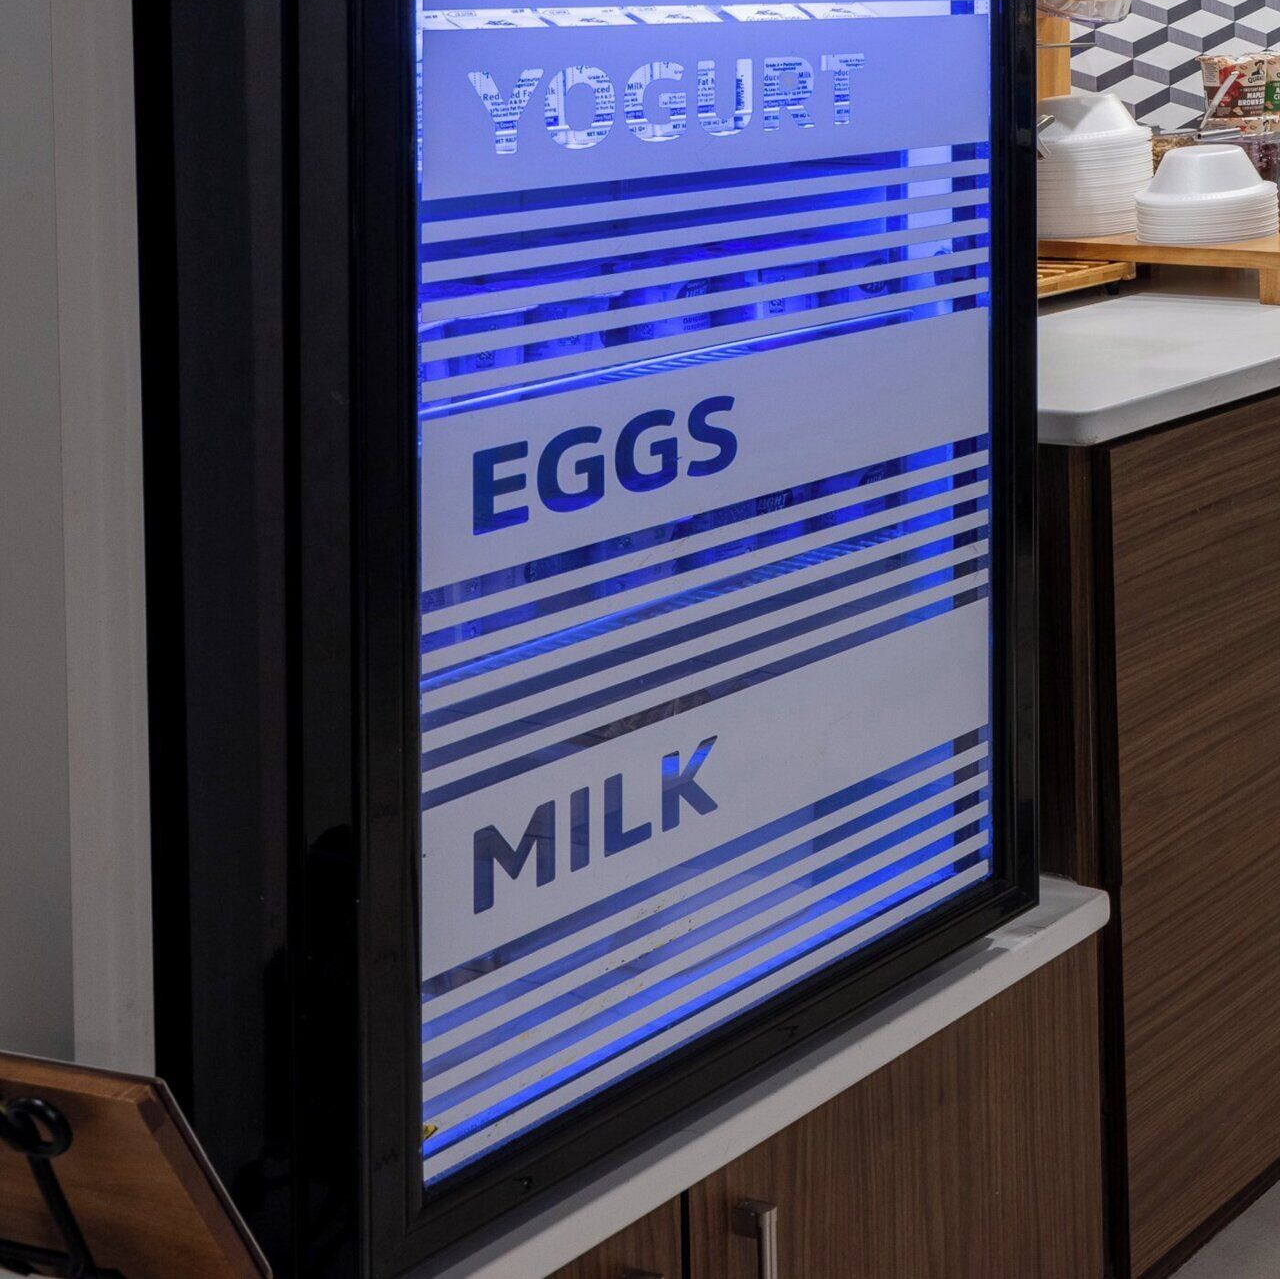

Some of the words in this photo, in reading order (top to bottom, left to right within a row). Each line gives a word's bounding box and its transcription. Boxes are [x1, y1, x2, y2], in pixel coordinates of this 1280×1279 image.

[468, 53, 865, 154] YOGURT
[473, 395, 738, 536] EGGS
[473, 735, 718, 915] MILK
